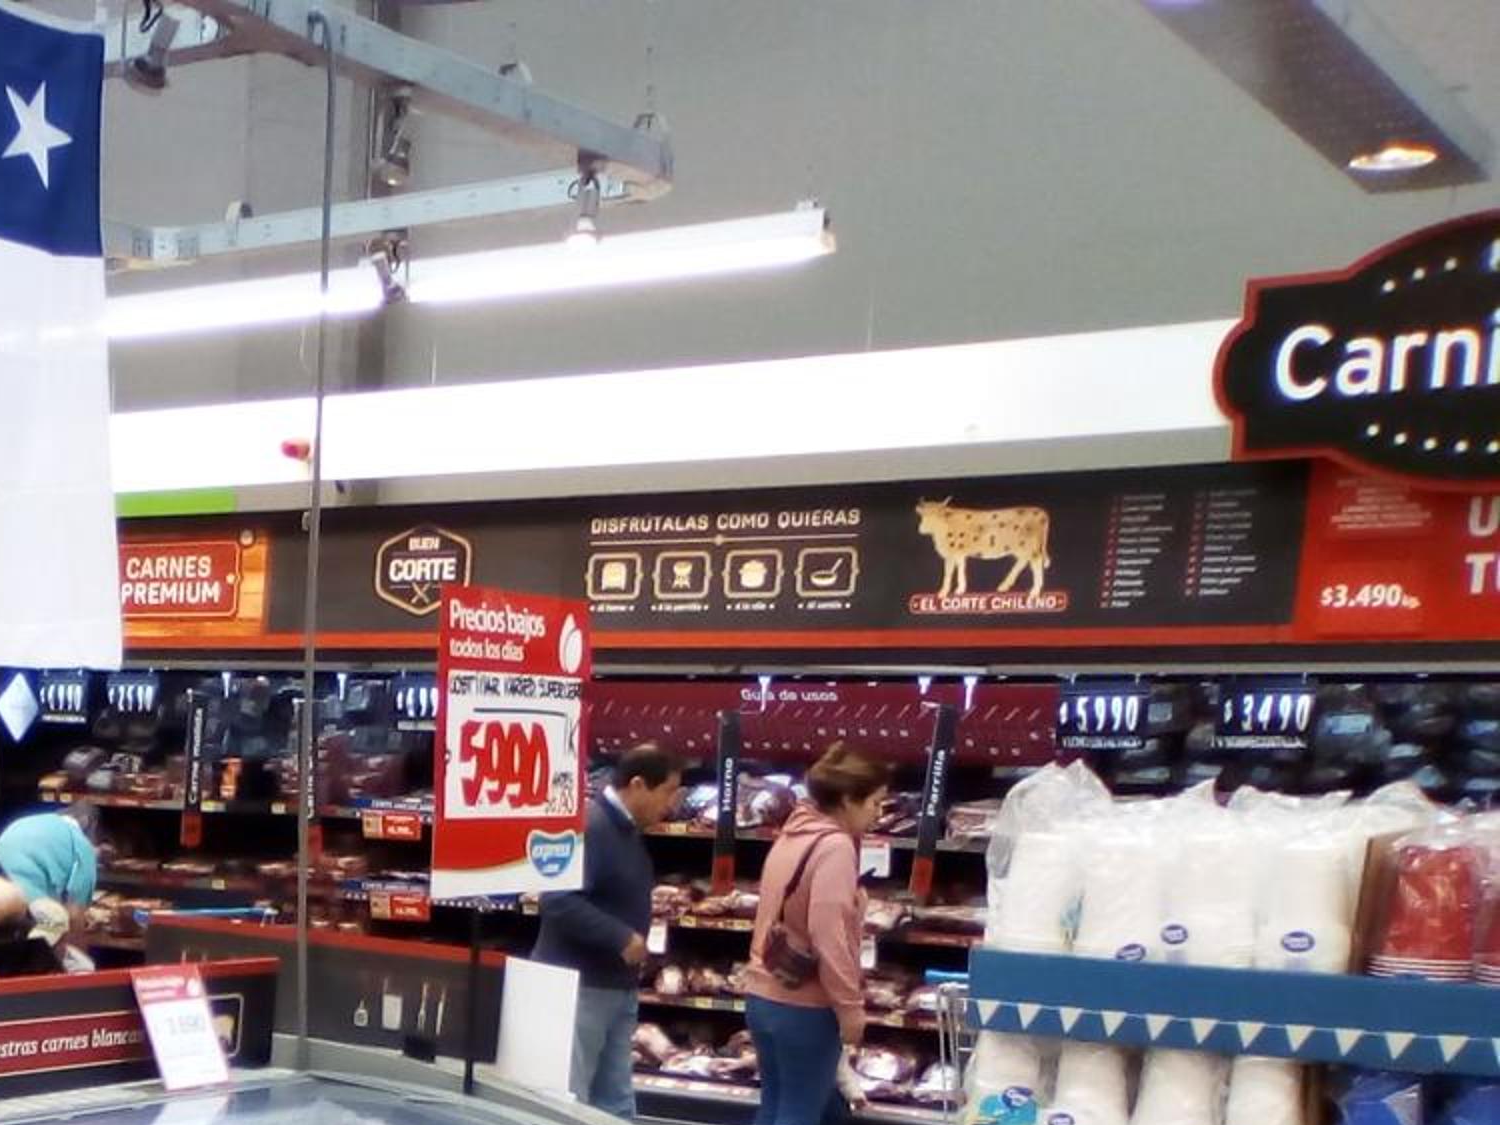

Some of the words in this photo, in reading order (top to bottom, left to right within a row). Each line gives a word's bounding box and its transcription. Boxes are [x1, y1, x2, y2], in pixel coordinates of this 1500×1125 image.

[717, 512, 769, 530] COMO
[777, 508, 861, 529] QUIERAS
[409, 536, 440, 550] BUEN
[125, 556, 212, 580] CARNES
[389, 557, 457, 582] CORTE
[1465, 553, 1500, 595] T
[120, 580, 221, 605] PREMIUM
[919, 600, 936, 612] EL
[942, 598, 985, 611] CORTE
[992, 597, 1057, 610] CHILENO
[449, 598, 505, 633] Precios
[505, 604, 546, 643] bajos
[740, 689, 776, 701] Gua
[779, 689, 797, 701] de
[800, 690, 838, 702] usos
[721, 756, 734, 812] Horno
[926, 749, 946, 818] Parrilla
[41, 1033, 89, 1053] carnes
[91, 1026, 143, 1047] blanca
